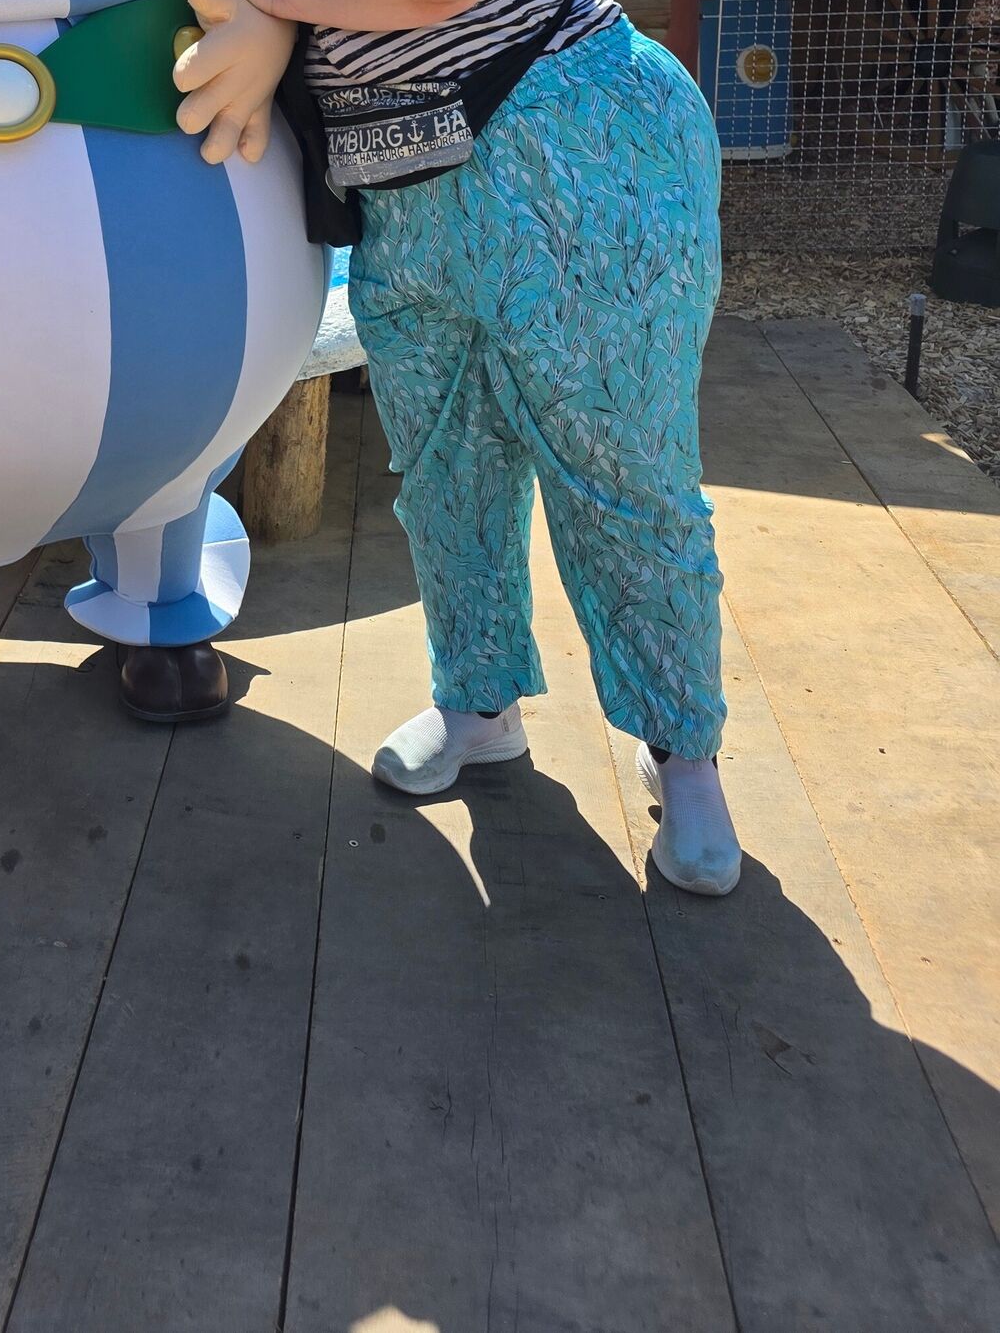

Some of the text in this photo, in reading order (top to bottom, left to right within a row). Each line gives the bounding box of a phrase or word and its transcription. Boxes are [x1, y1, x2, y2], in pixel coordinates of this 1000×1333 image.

[433, 109, 466, 137] HA
[360, 146, 405, 165] HAMBURG
[408, 133, 456, 156] HAMBURG
